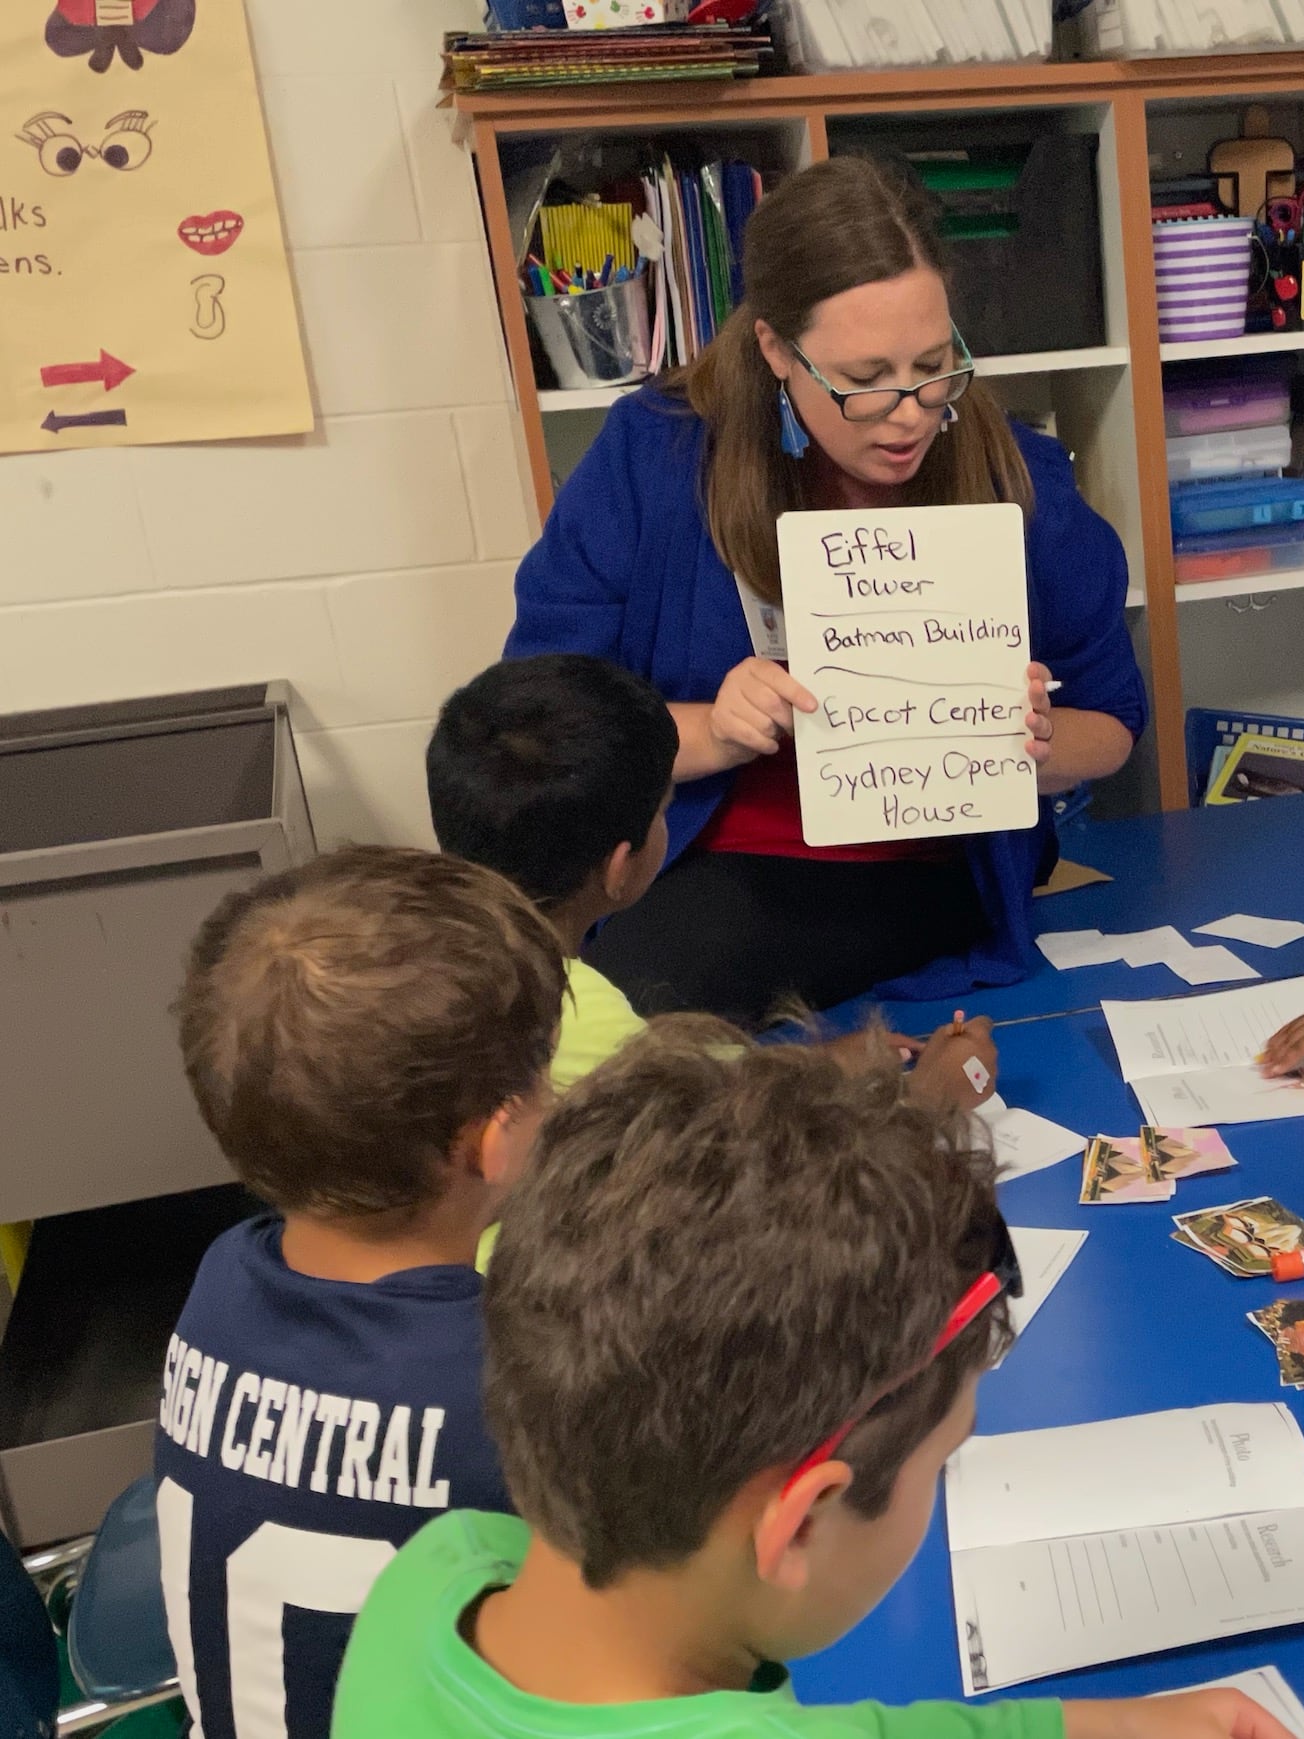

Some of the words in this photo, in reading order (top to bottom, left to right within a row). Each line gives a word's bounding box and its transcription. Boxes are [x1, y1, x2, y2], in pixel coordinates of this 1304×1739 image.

[0, 196, 47, 232] lks
[821, 527, 917, 569] Eiffel
[833, 572, 935, 599] Tower
[822, 627, 915, 652] Batman
[923, 618, 1022, 648] Building
[822, 695, 917, 732] Epcot
[929, 698, 1022, 726] Center
[819, 762, 931, 801] Sydney
[942, 751, 1033, 786] Opera
[882, 794, 983, 828] House
[221, 1371, 451, 1509] CENTRAL
